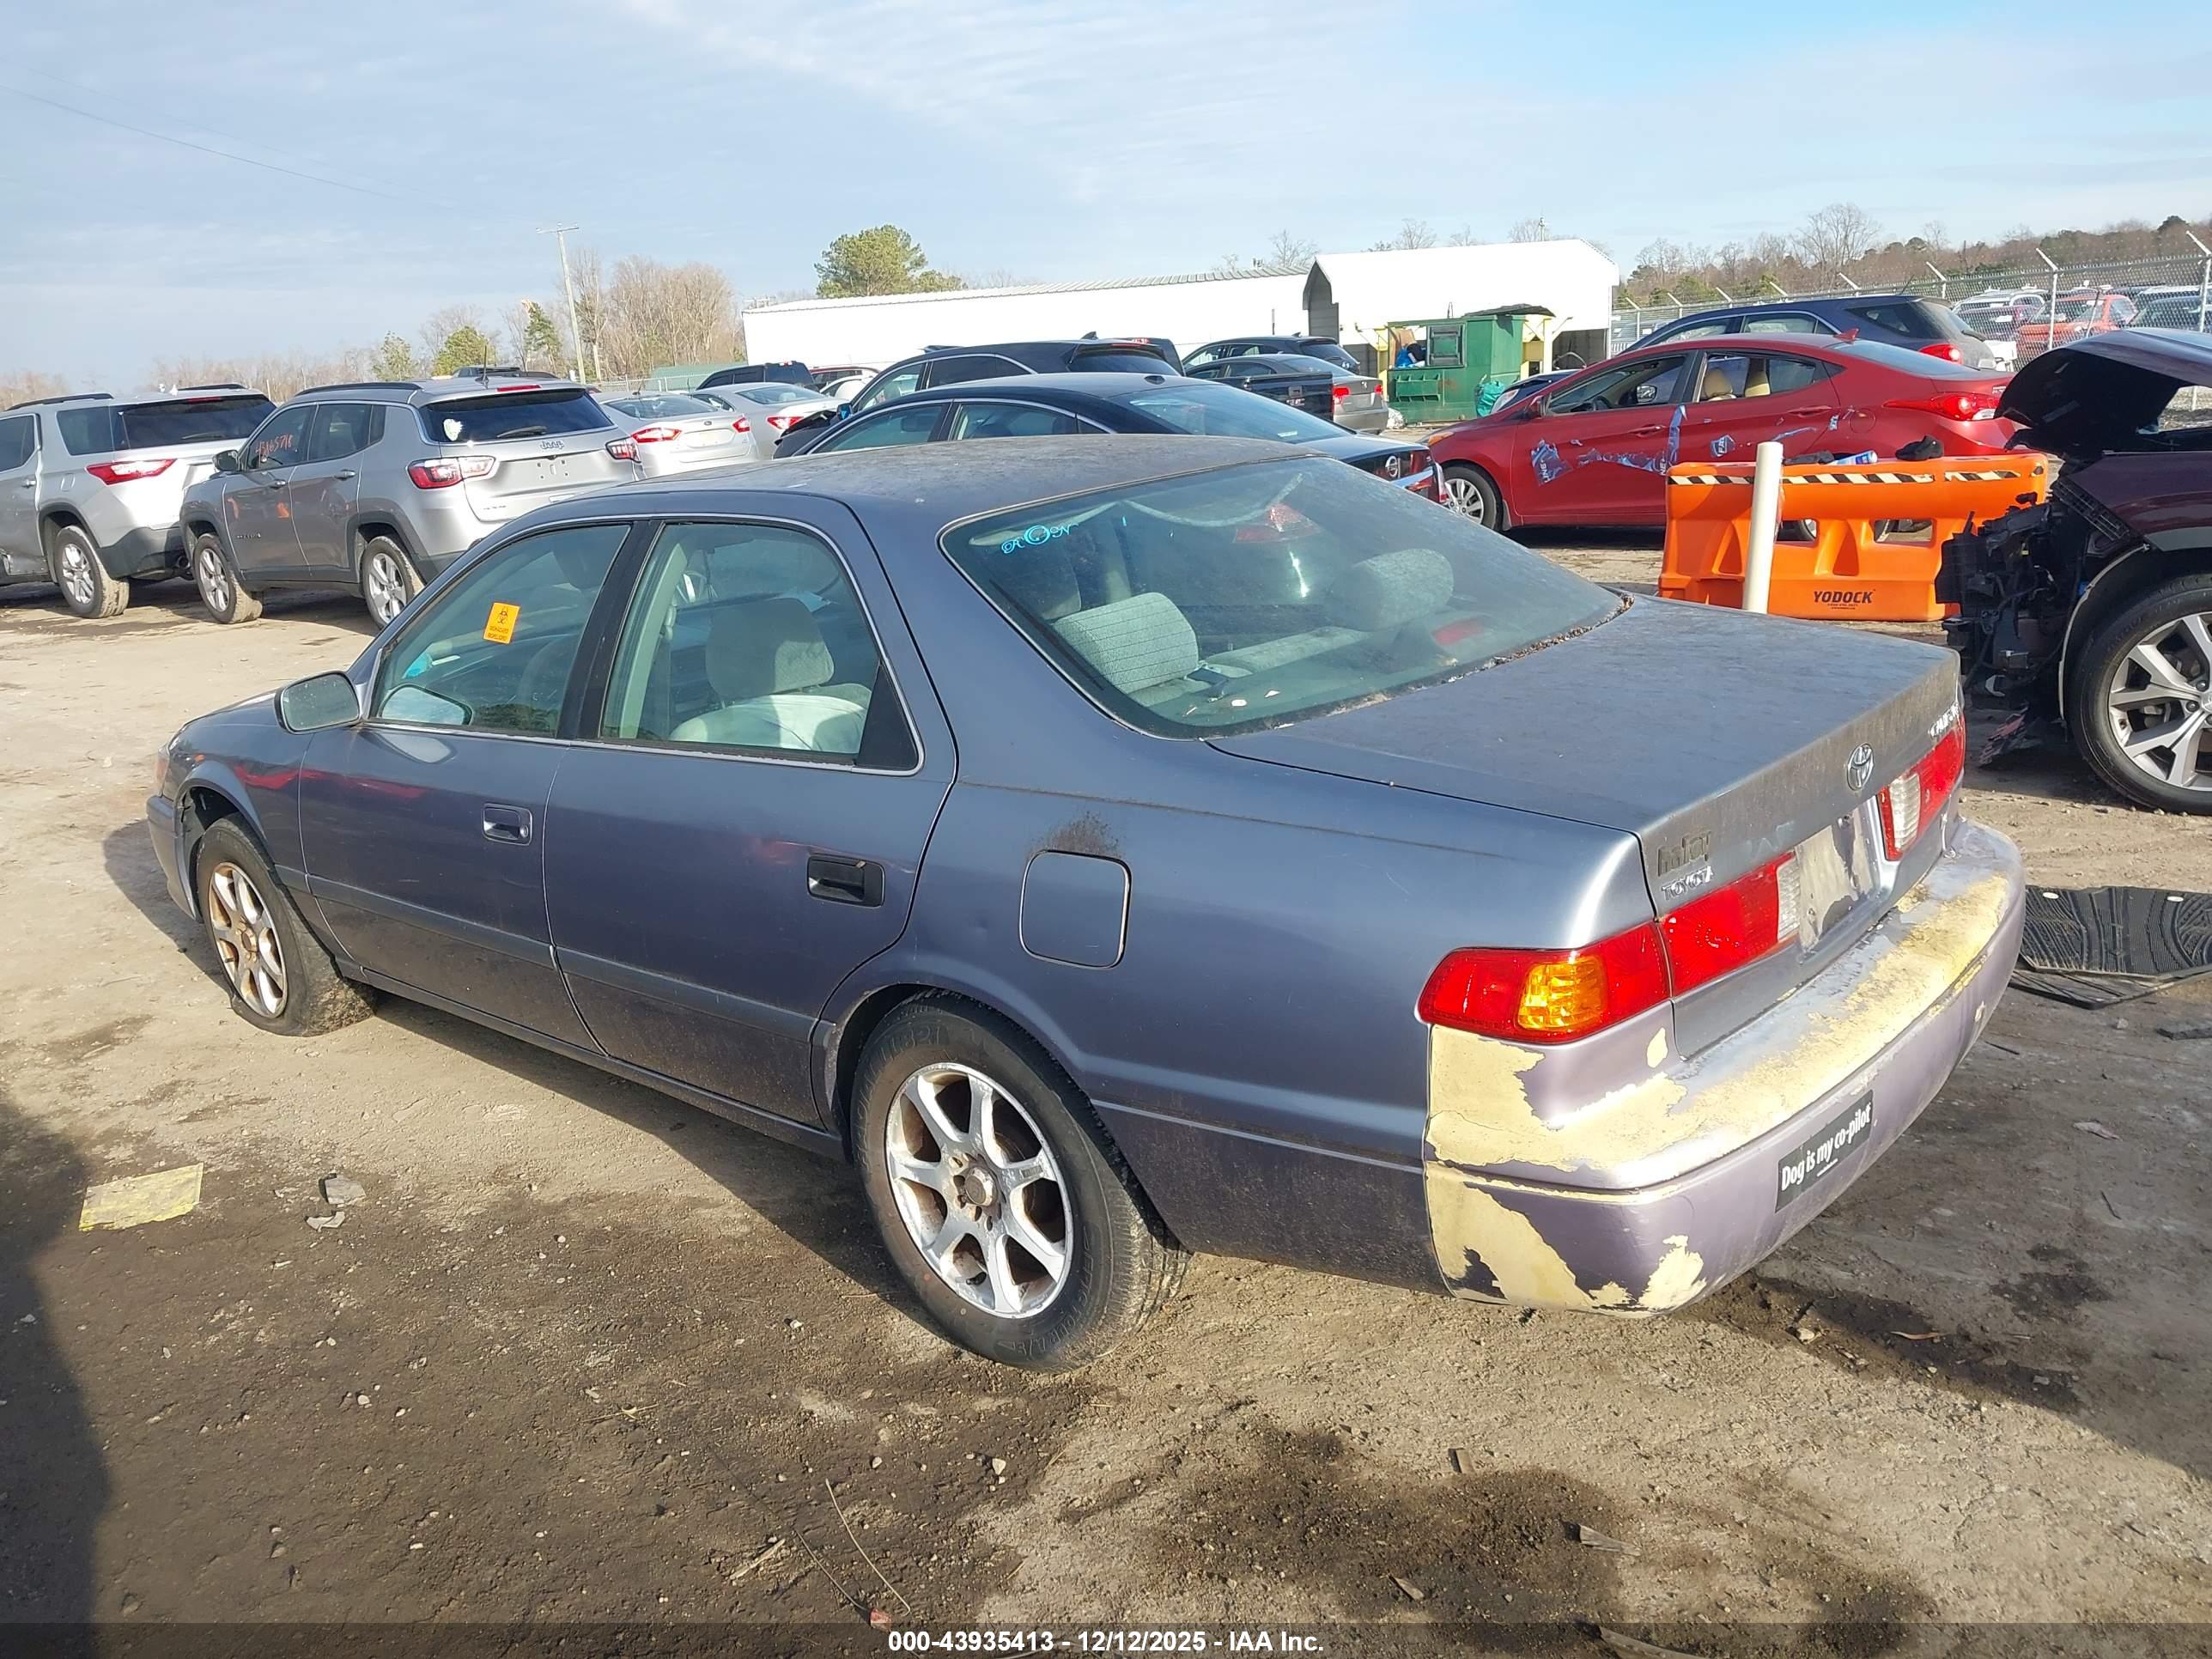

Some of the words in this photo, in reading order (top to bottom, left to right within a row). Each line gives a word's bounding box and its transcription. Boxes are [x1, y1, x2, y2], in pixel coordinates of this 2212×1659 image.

[1814, 591, 1873, 604] YODOCK
[1781, 1160, 1805, 1191] Dog
[1806, 1150, 1816, 1173] is
[1816, 1137, 1834, 1163] my
[1834, 1104, 1871, 1150] co-pilot
